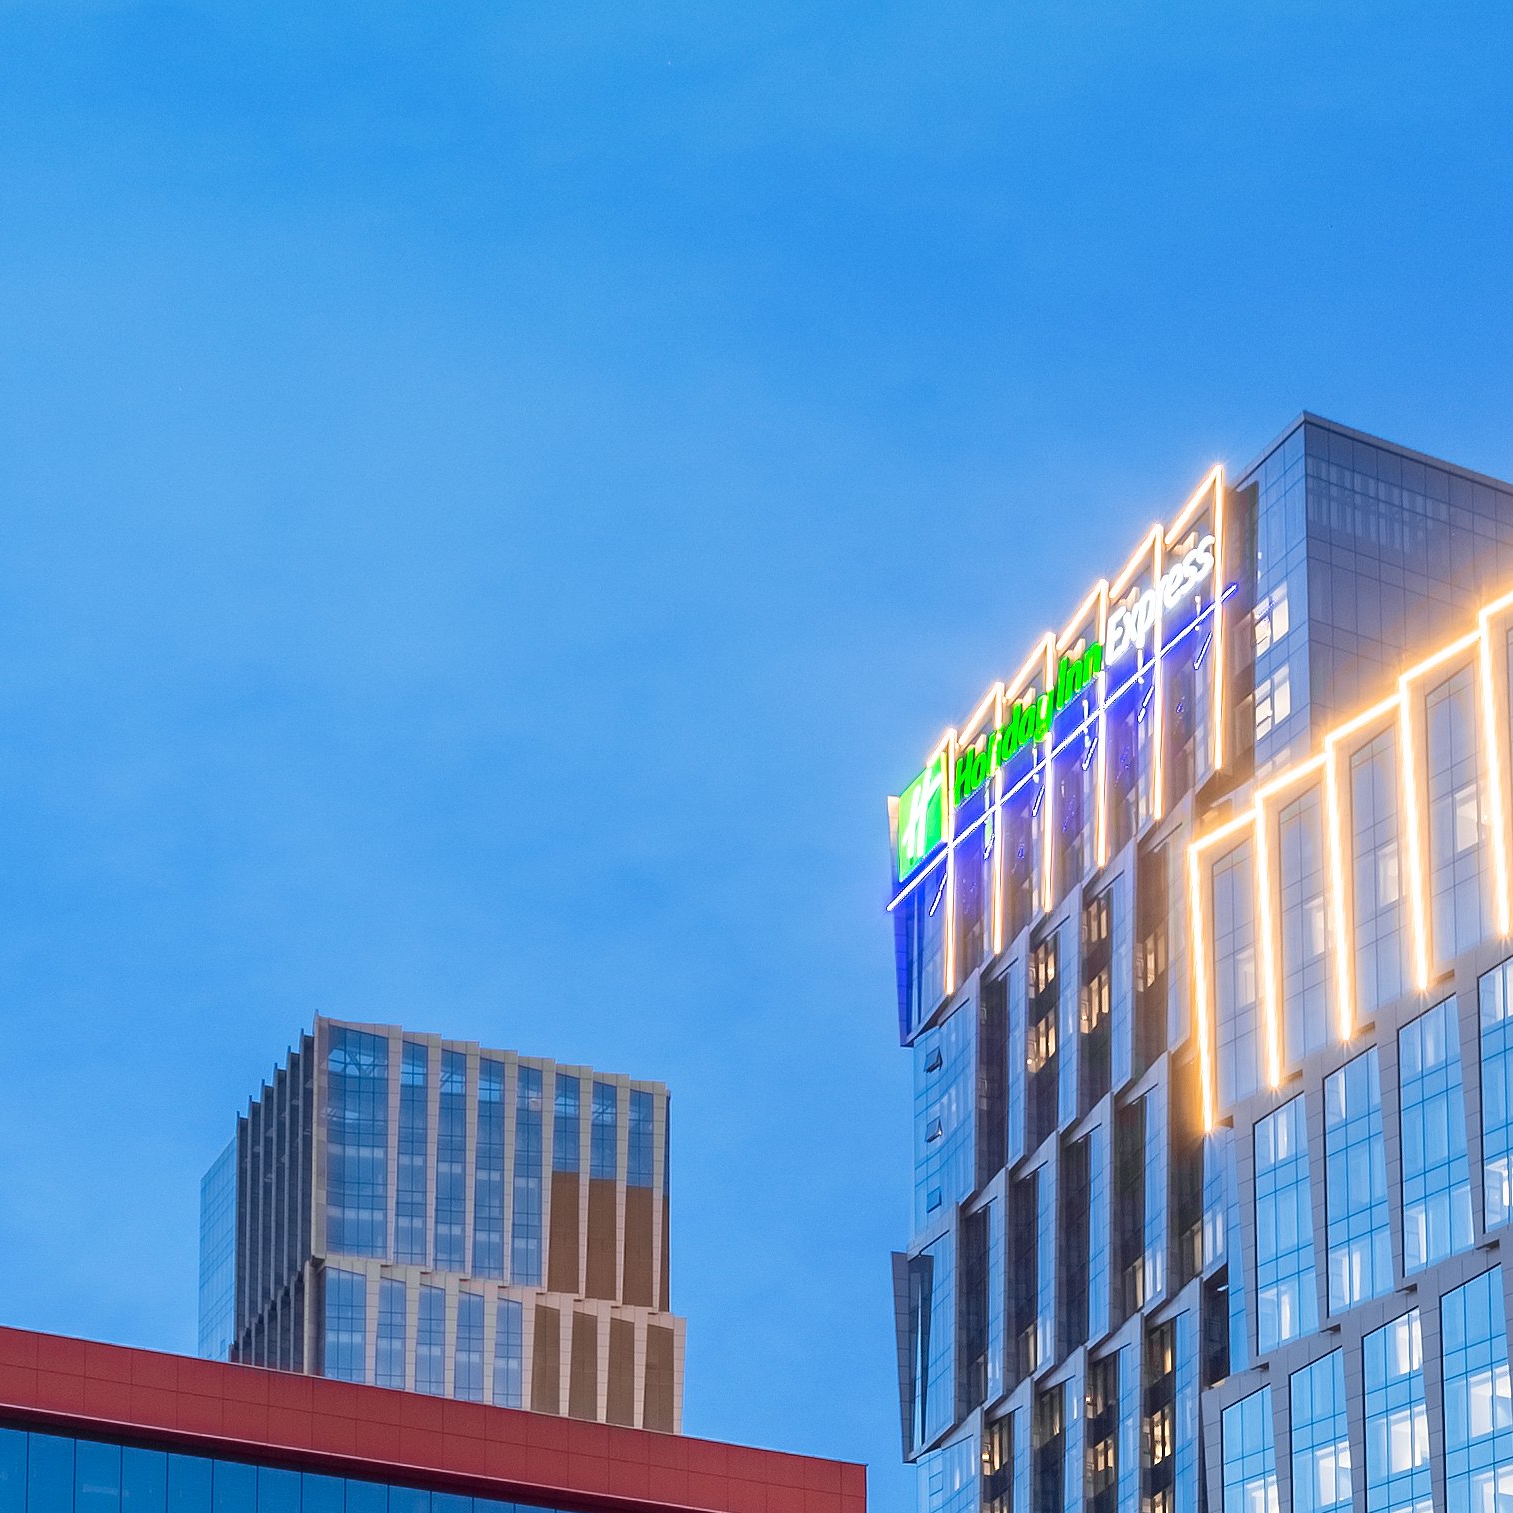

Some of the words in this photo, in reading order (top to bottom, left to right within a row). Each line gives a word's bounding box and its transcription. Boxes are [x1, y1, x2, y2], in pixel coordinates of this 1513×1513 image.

[954, 686, 1054, 808] Holiday
[1056, 641, 1103, 711] Inn
[1105, 534, 1216, 666] Express
